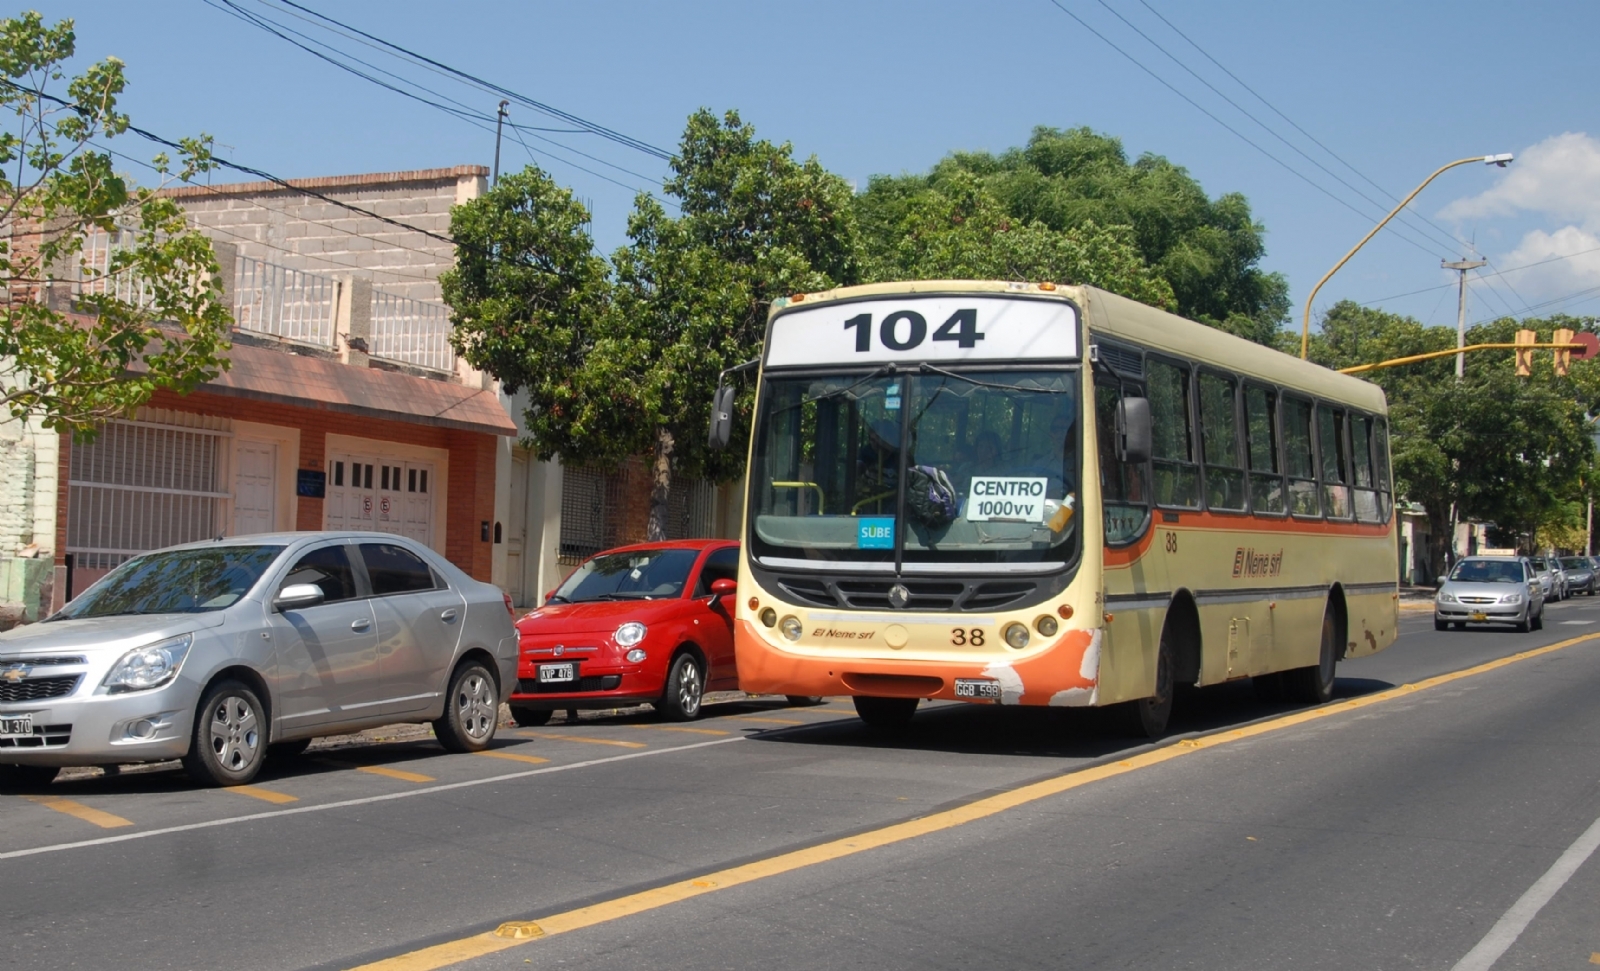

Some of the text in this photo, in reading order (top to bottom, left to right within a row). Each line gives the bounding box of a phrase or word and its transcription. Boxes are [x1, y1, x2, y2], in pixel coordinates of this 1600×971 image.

[844, 308, 985, 352] 104
[973, 481, 1043, 497] CENTRO
[861, 526, 891, 538] SUBE
[1166, 532, 1178, 553] 38
[1232, 547, 1284, 578] El Nene srl
[812, 628, 876, 639] El Nene srl
[951, 628, 985, 646] 38
[558, 668, 572, 678] 478
[957, 684, 998, 697] GGB 598
[13, 720, 31, 733] 370
